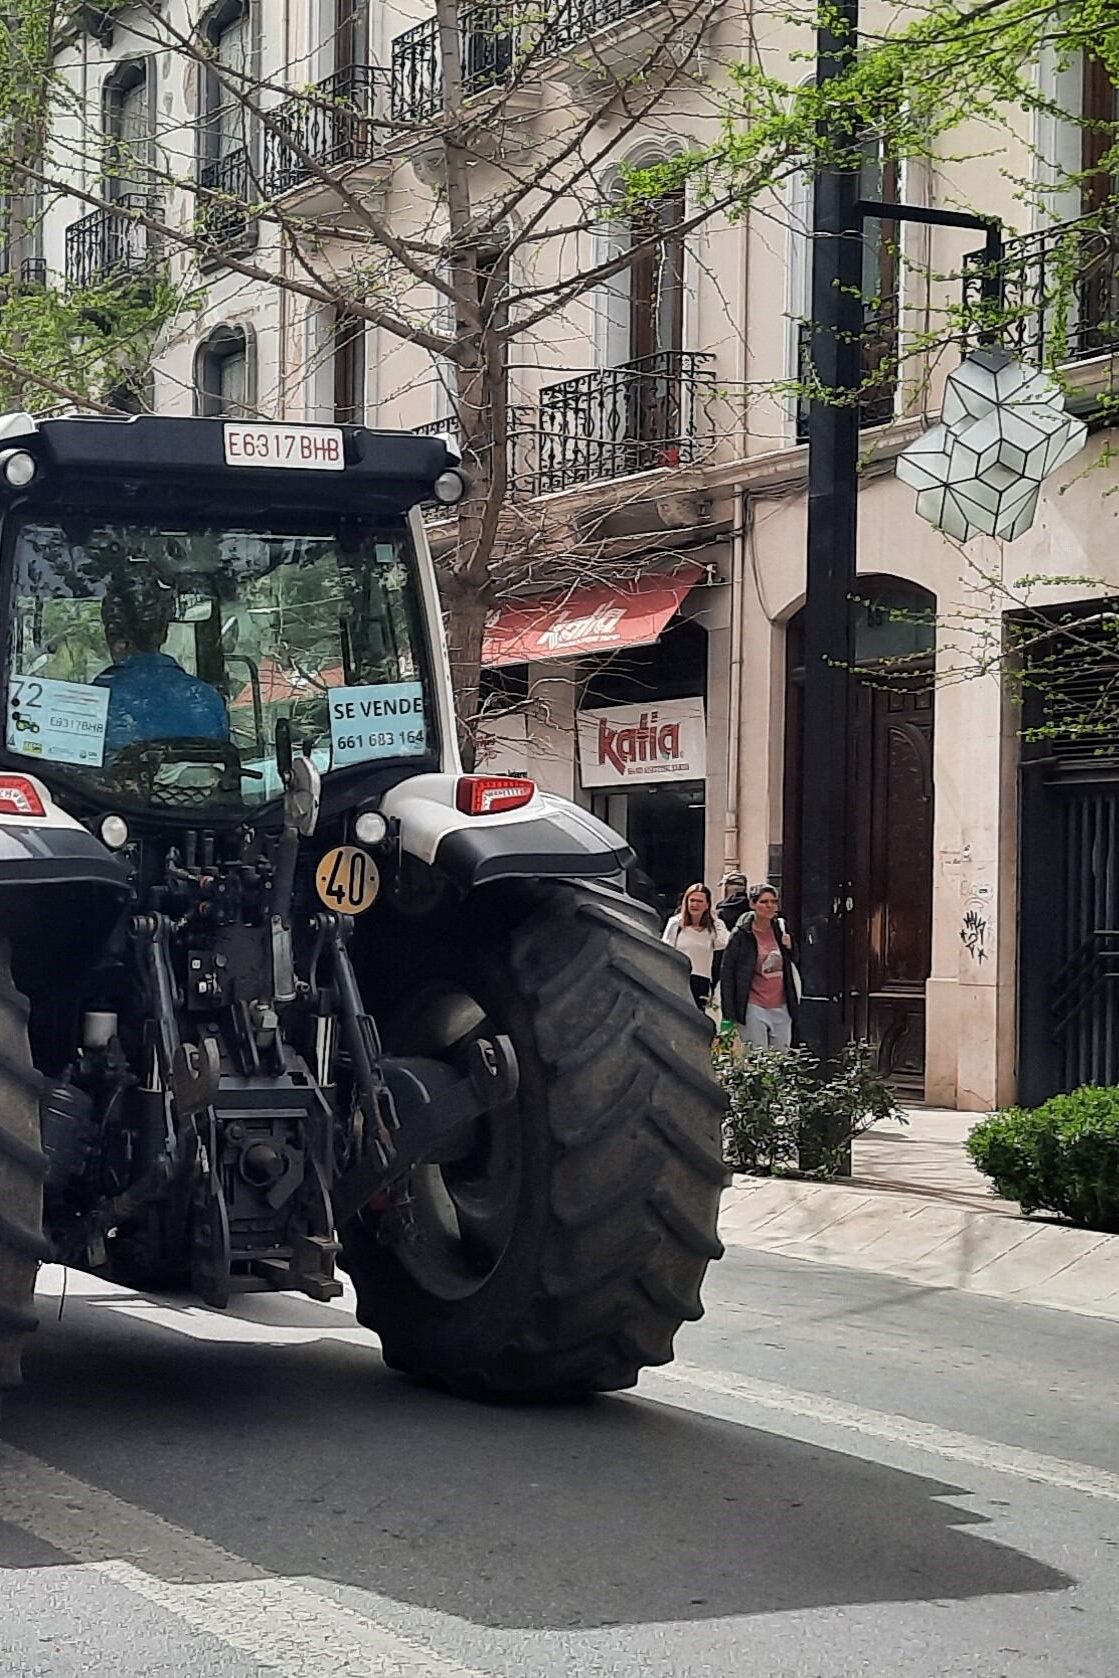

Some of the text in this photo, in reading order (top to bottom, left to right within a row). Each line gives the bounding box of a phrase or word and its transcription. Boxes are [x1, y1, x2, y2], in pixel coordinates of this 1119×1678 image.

[334, 697, 423, 720] SE VENDE
[337, 734, 363, 750] 661
[368, 732, 394, 747] 683
[598, 710, 680, 776] katia
[326, 850, 366, 906] 40
